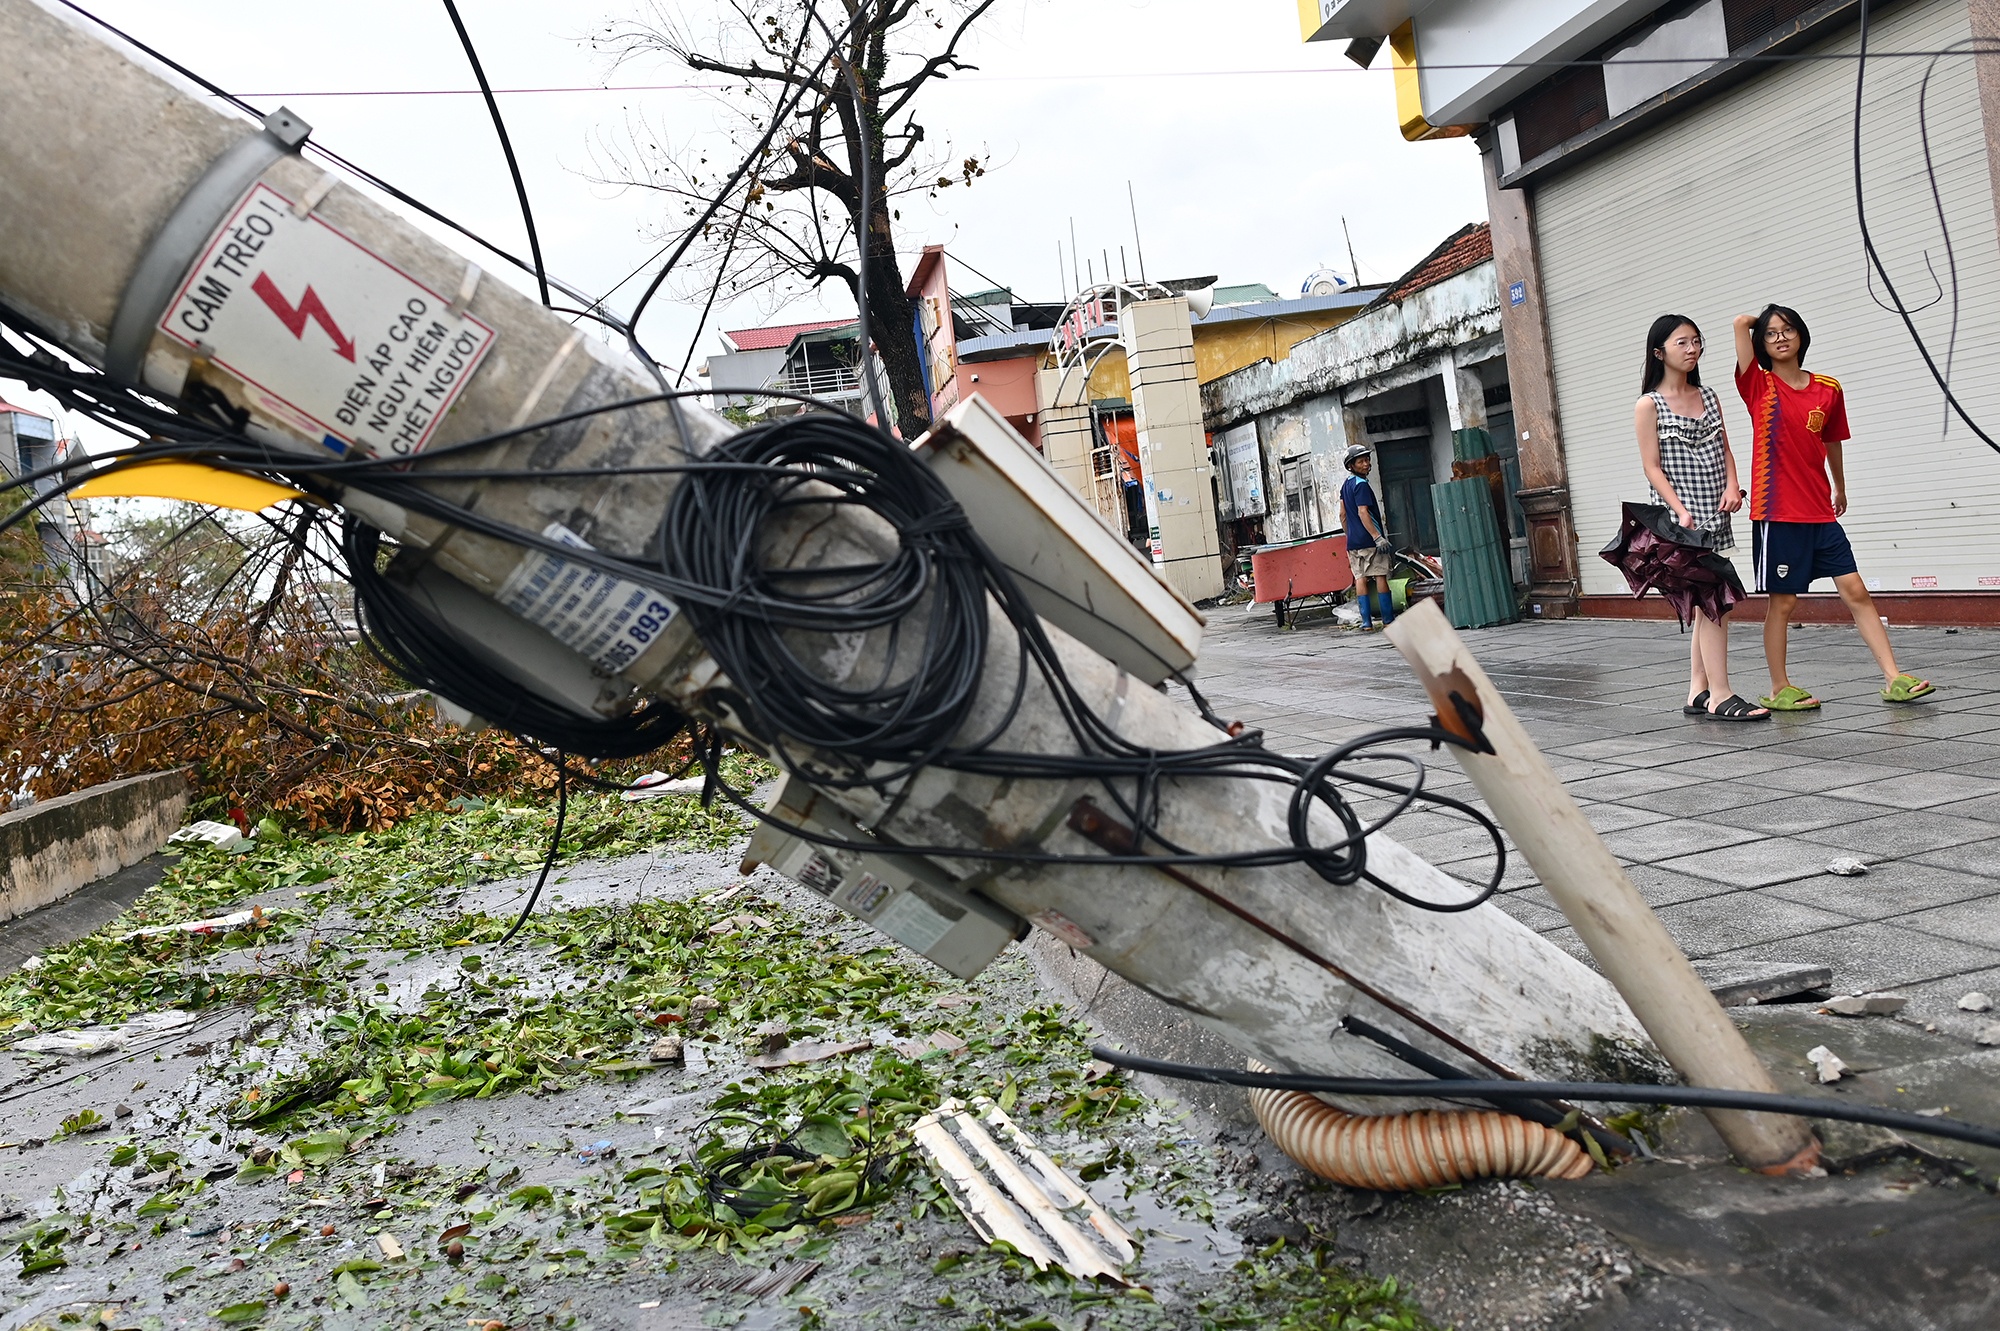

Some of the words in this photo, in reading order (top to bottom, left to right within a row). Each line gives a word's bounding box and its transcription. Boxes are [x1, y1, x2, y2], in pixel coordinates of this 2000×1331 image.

[180, 276, 232, 333] CẤM
[212, 214, 273, 277] TRÈO
[335, 374, 377, 427] ĐIỆN
[369, 343, 393, 376] ÁP
[389, 298, 427, 342] CAO
[367, 372, 413, 434] NGUY
[405, 321, 449, 374] HIỂM
[390, 399, 432, 458] CHẾT
[424, 330, 479, 400] NGƯỜI
[629, 601, 671, 643] 893
